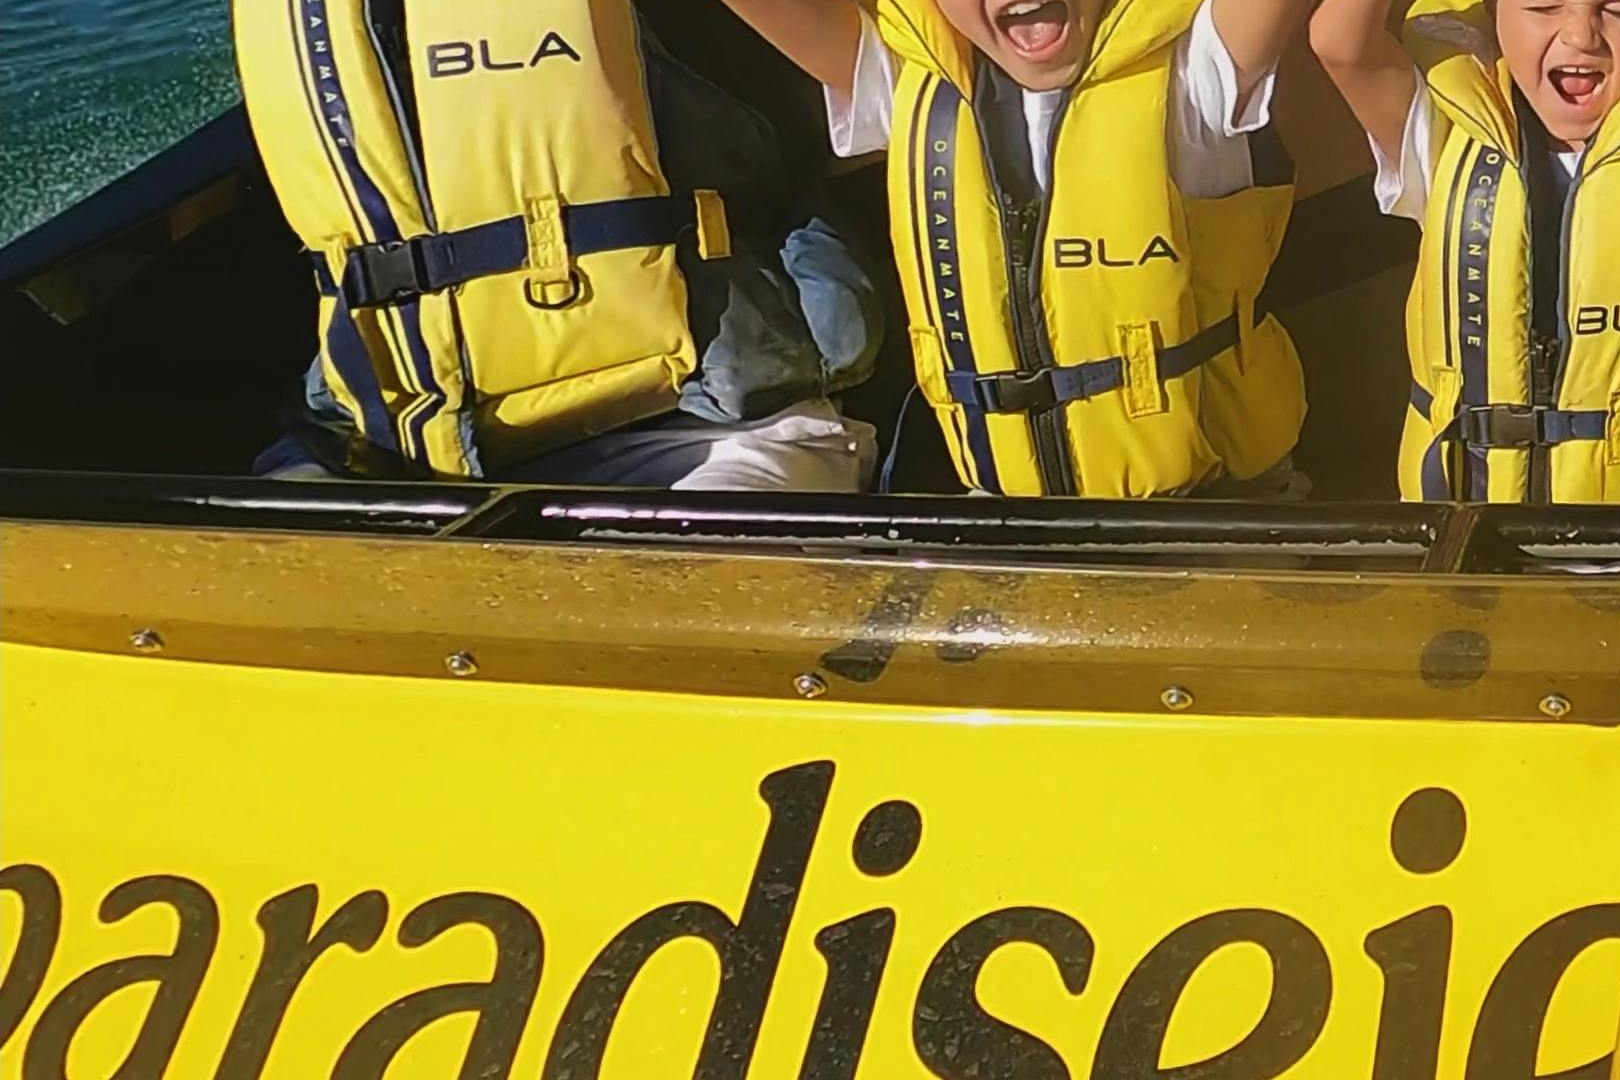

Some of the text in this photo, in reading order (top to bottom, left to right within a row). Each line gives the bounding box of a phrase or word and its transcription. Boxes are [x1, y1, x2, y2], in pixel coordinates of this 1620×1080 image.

[426, 31, 581, 78] BLA
[933, 140, 964, 341] OCEANMATE
[1054, 235, 1180, 269] BLA
[1466, 152, 1500, 347] OCEANMATE
